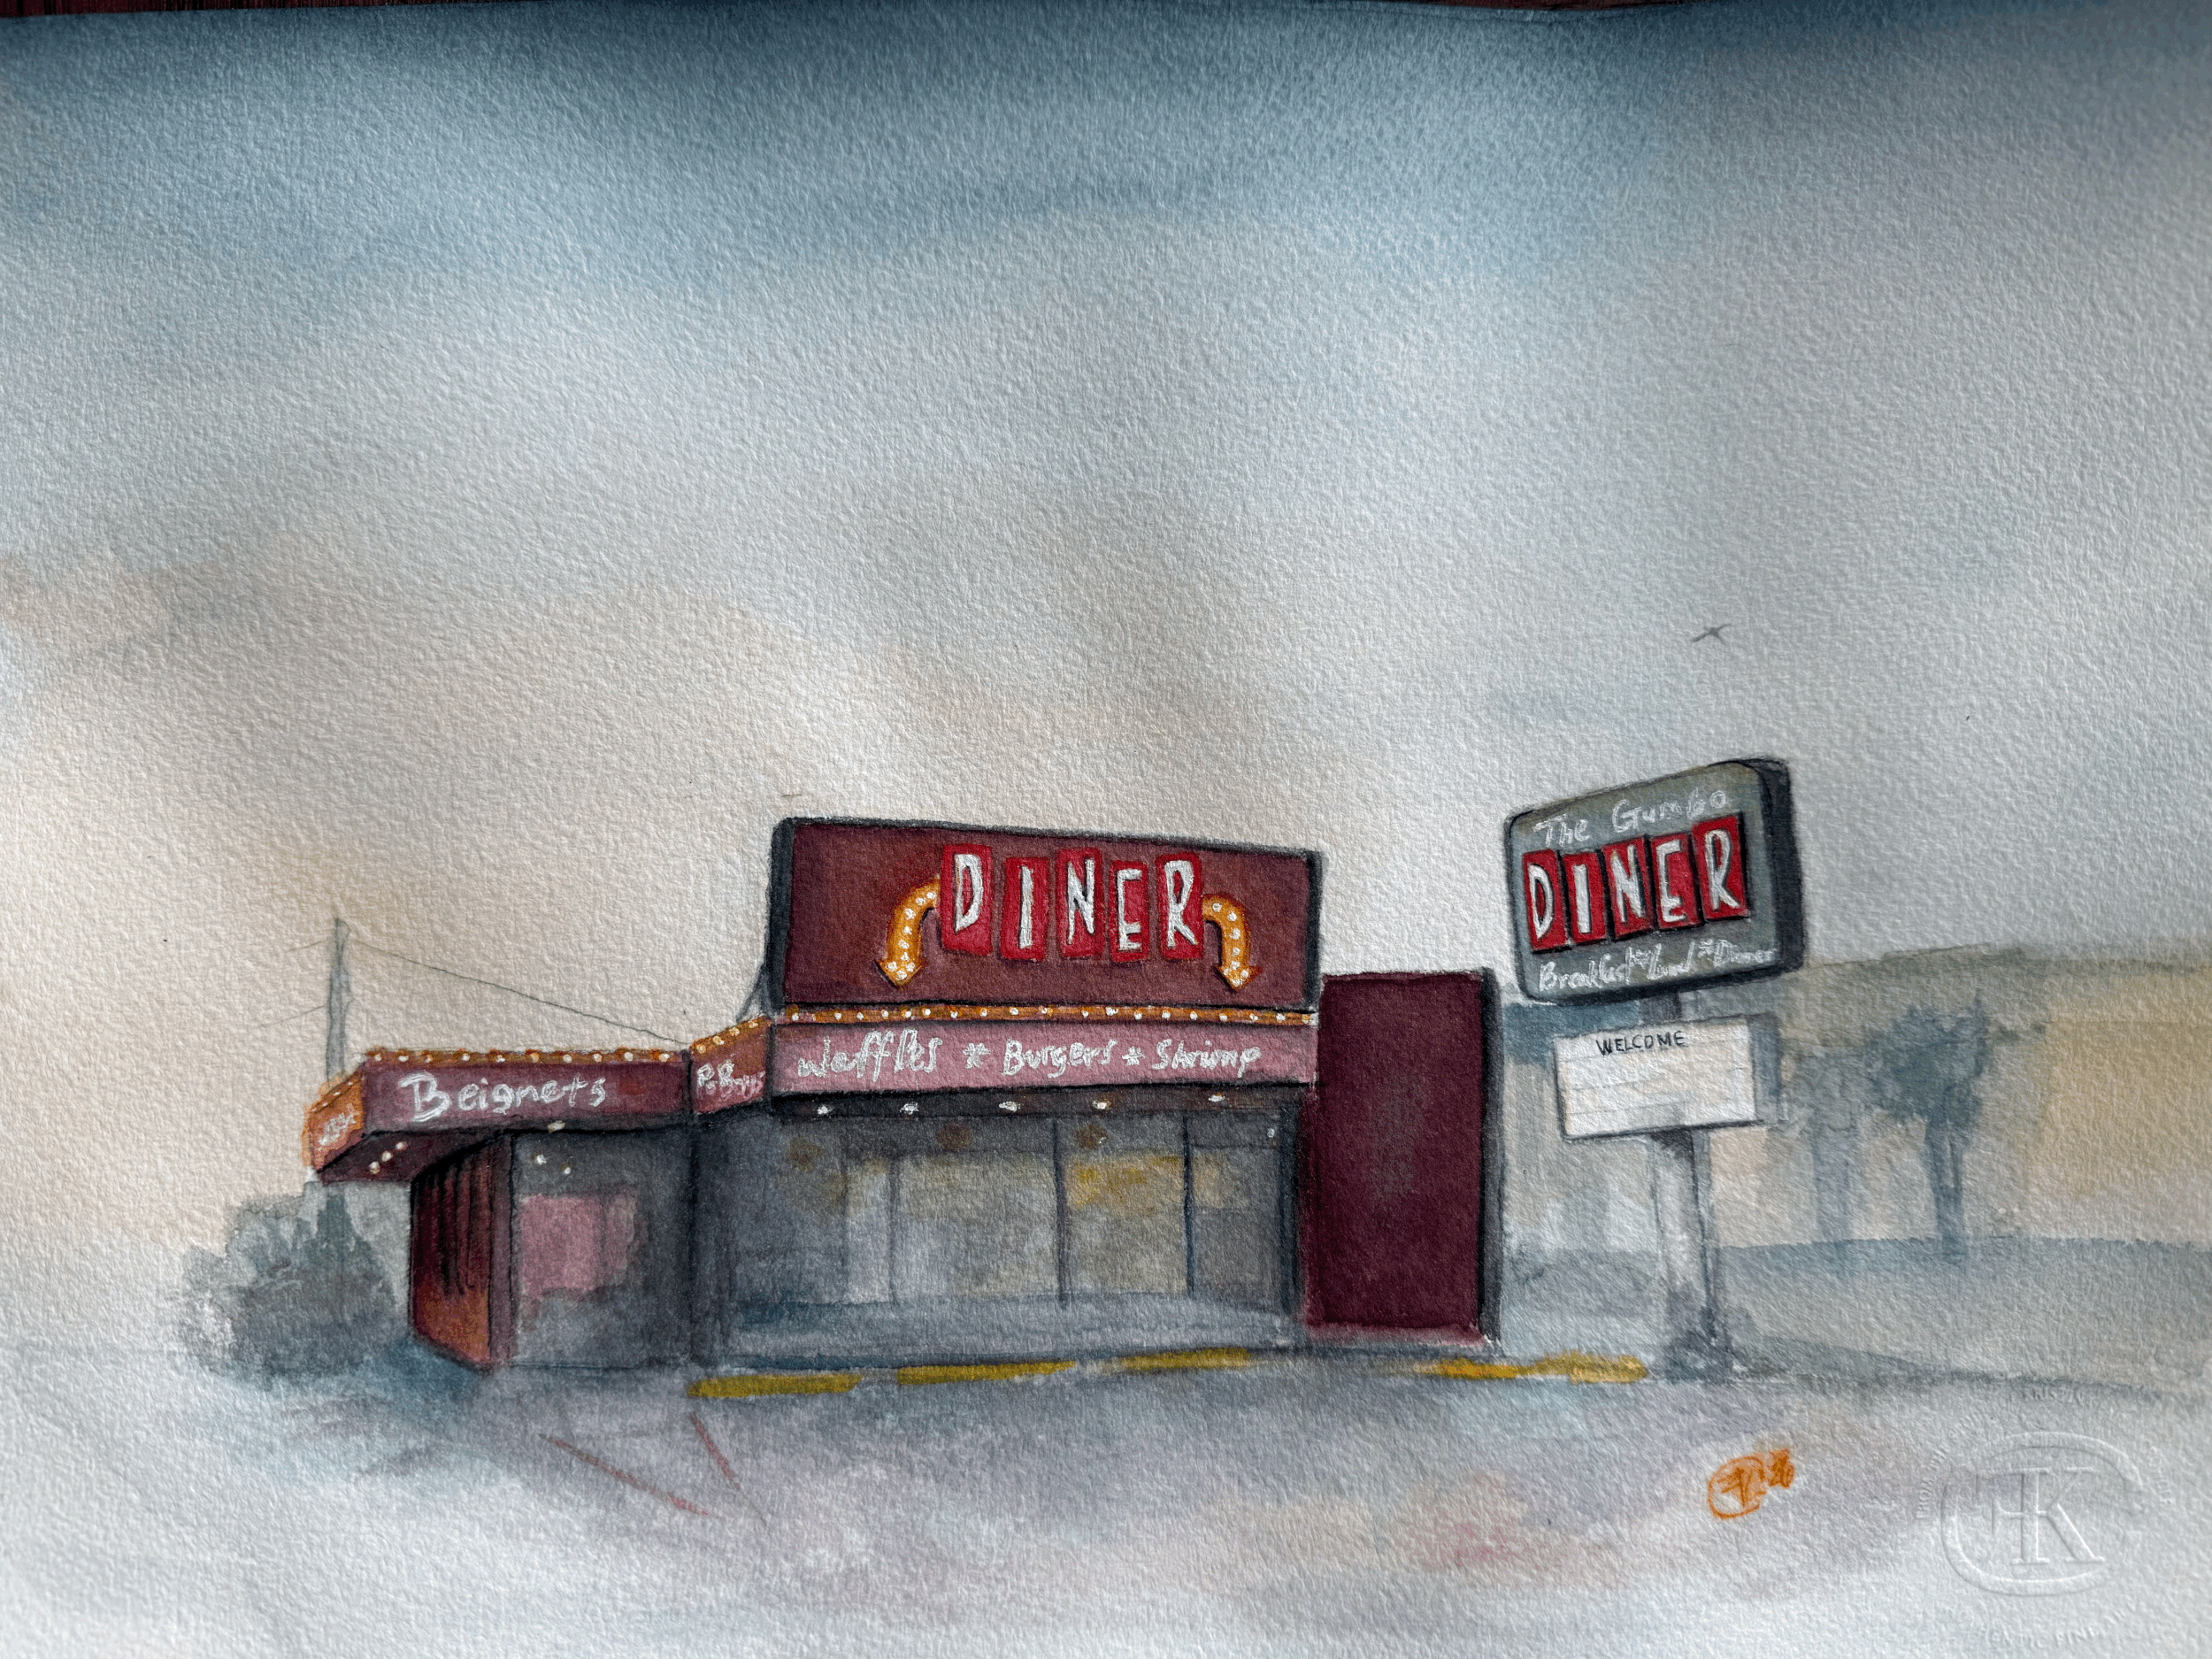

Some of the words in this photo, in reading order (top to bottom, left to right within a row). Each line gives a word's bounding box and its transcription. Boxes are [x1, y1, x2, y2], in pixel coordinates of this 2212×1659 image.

[1532, 813, 1590, 847] The
[1612, 787, 1726, 833] Gumbo
[952, 853, 1196, 952] DINER
[1527, 829, 1740, 939] DINER
[1002, 1036, 1118, 1078] Burgers
[1151, 1039, 1261, 1079] Shrimp
[1595, 1030, 1685, 1056] WELCOME
[398, 1069, 607, 1125] Beignets
